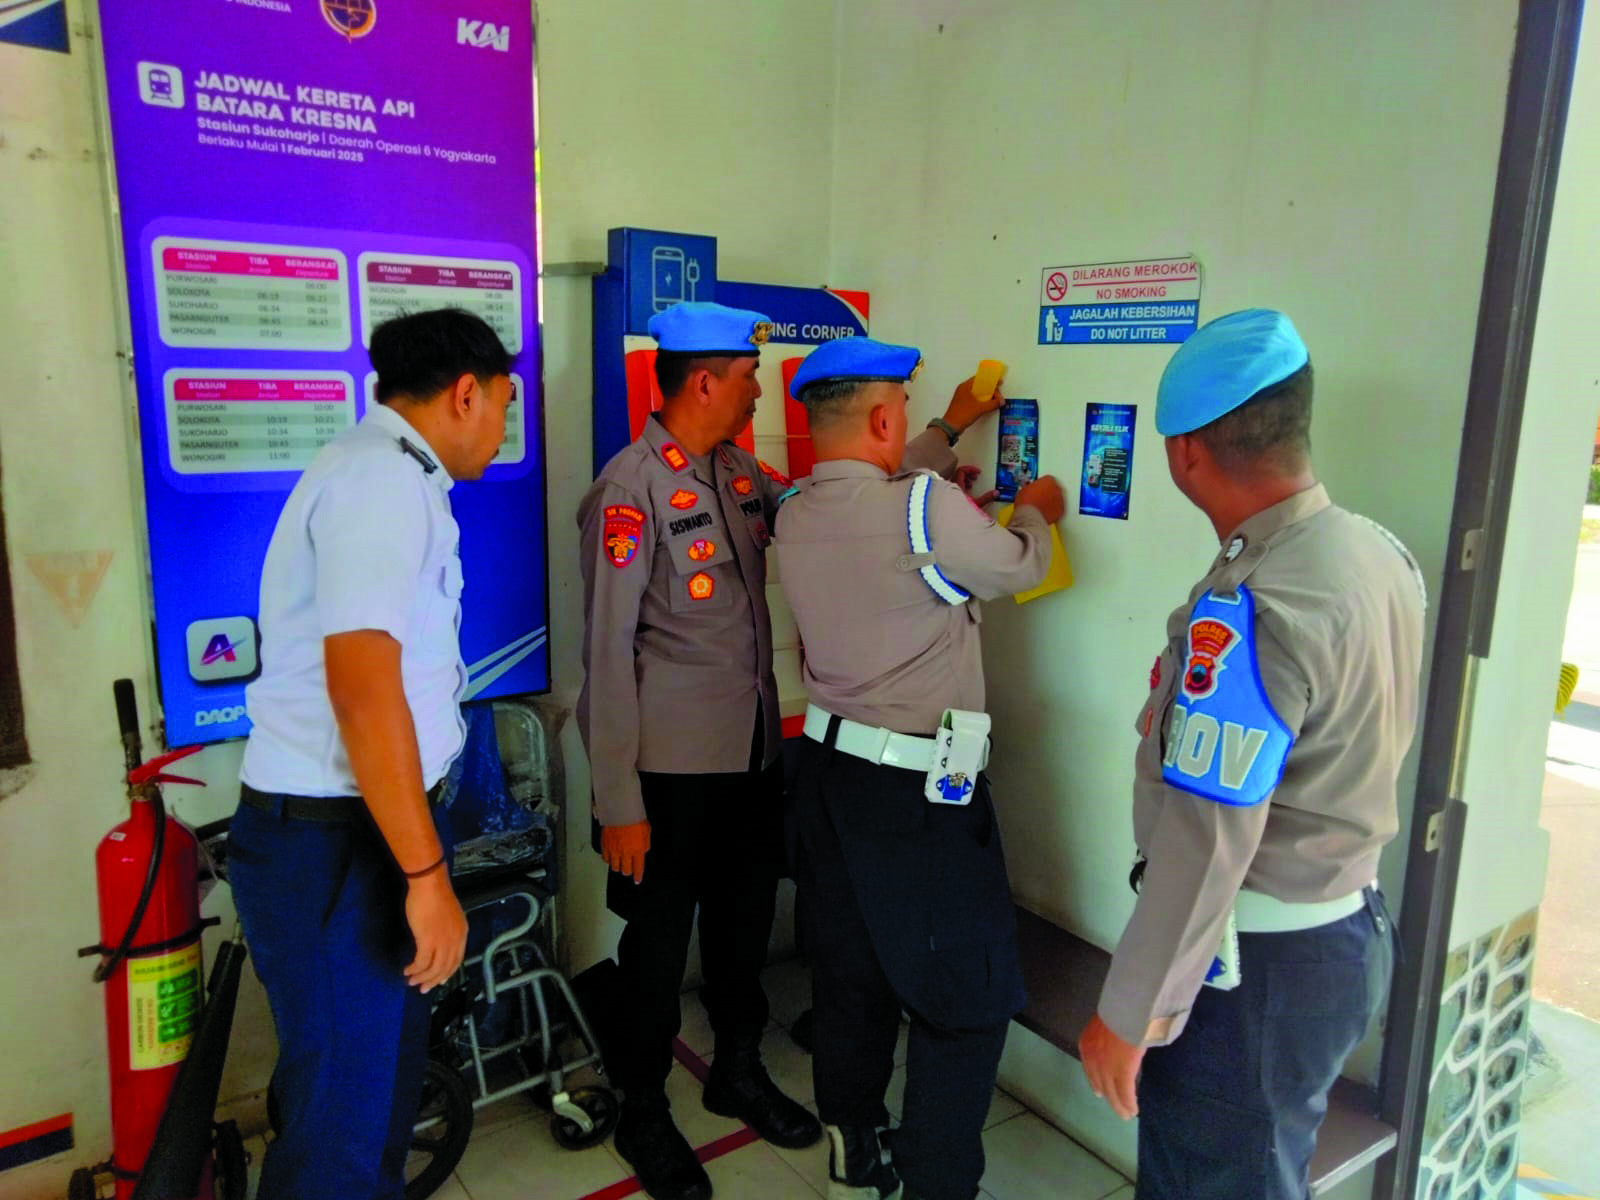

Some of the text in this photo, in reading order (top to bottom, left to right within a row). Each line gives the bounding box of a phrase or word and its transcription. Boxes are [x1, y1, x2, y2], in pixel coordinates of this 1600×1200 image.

[457, 18, 510, 52] KAI
[194, 70, 416, 119] JADWAL KERETA API
[196, 92, 377, 134] BATARA KRESNA
[197, 116, 497, 165] Stasiun Sukoharjo Daerah Operasi 6 Yogyakarta
[198, 133, 364, 163] Berlaku Mulai 1 Februari 2025
[177, 251, 337, 269] STASIUN TIBA BERANGKAT
[378, 265, 512, 280] STASIUN TIBA BERANGKAT
[1072, 261, 1198, 281] DILARANG MEROKOK
[1096, 286, 1167, 300] NO SMOKING
[1069, 305, 1196, 320] JAGALAH KEBERSIHAN
[1091, 327, 1167, 340] DO NOT LITTER
[188, 381, 344, 391] STASIUN TIBA BERANGKAT
[669, 512, 713, 536] SISWANTO
[195, 705, 246, 727] DAOP
